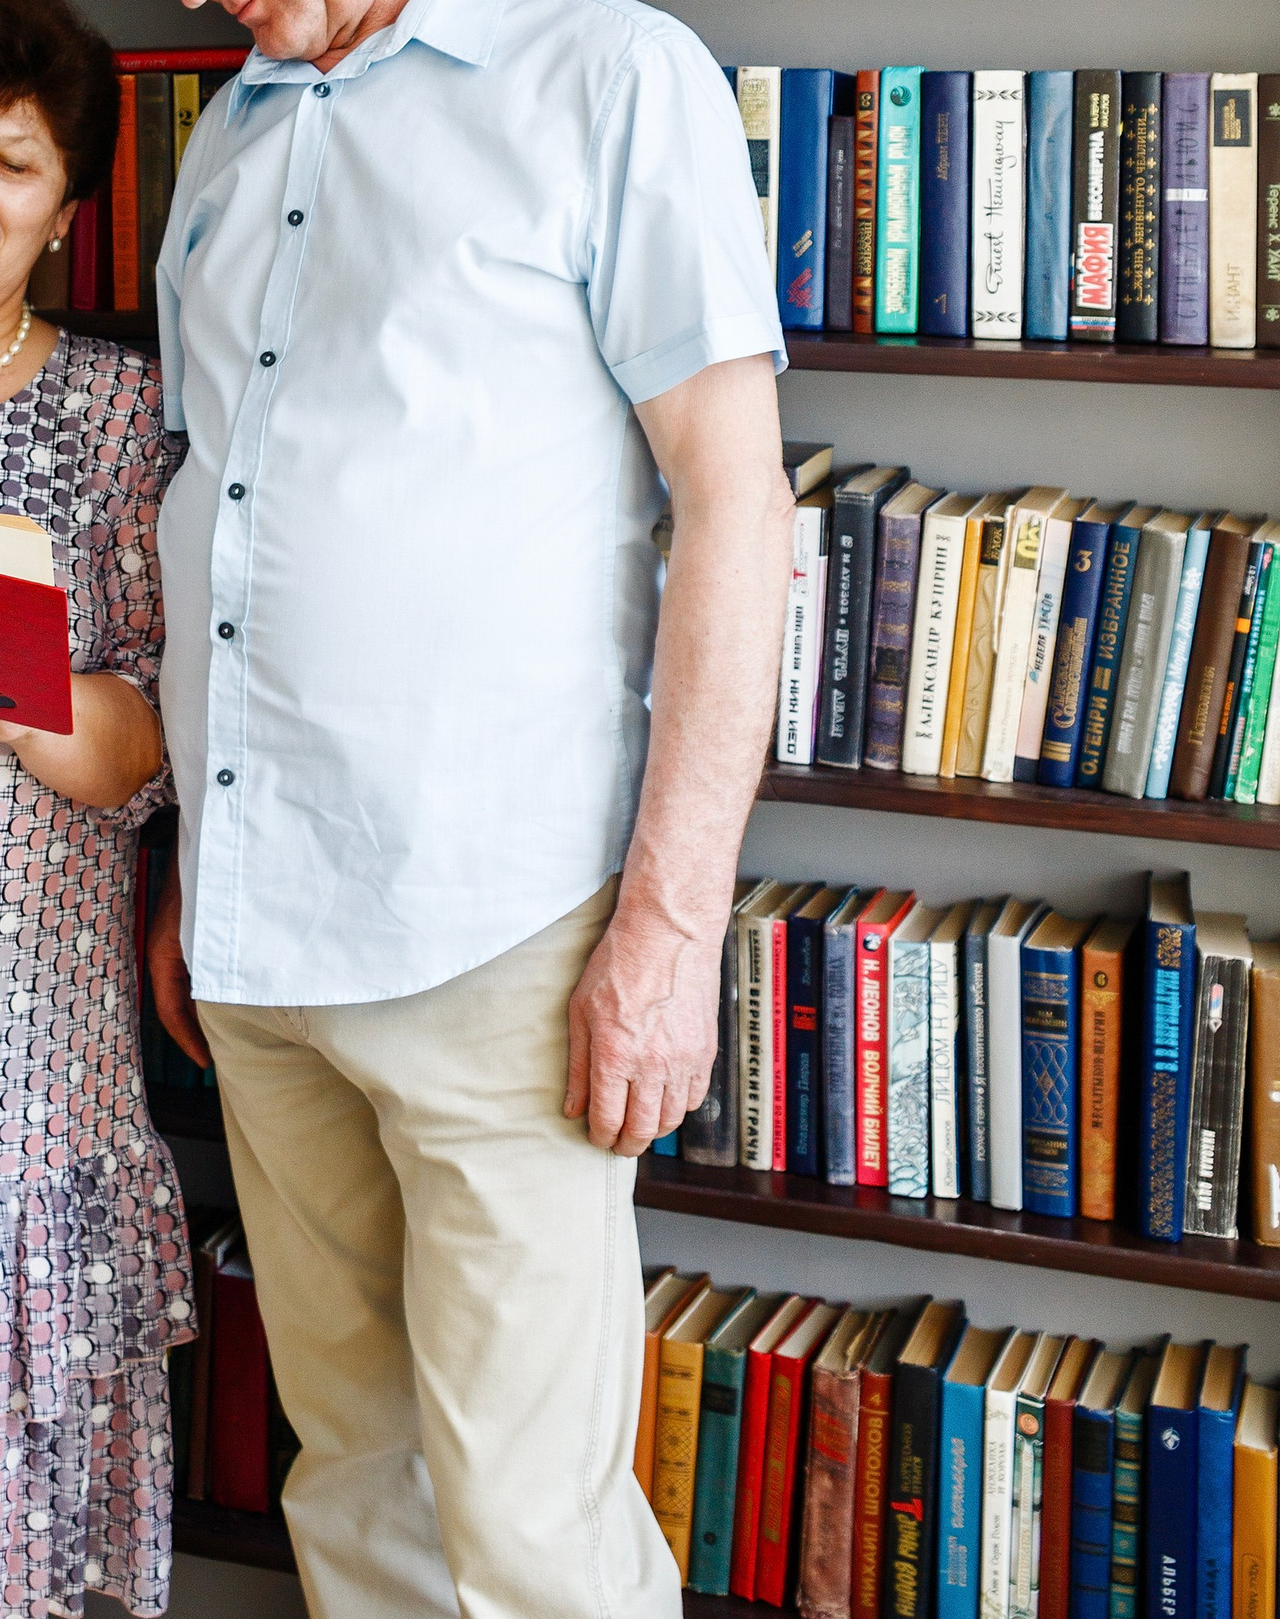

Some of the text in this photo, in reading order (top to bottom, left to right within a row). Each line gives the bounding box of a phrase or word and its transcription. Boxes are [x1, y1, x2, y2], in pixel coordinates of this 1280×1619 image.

[1091, 93, 1100, 127] ВАЛЕРИЙ
[1101, 94, 1110, 127] МАСЛОВ
[984, 120, 1017, 294] Ernest Hemingway
[1079, 131, 1107, 306] МАФИЯ БЕССМЕРТНА
[1134, 118, 1147, 289] ЖИЗНЬ БЕНВЕНУТО ЧЕЛЛИНИ
[920, 546, 949, 728] АЛЕКСАНДР КУПРИН
[1099, 541, 1131, 660] ИЗБРАННОЕ
[863, 981, 881, 1041] ЛЕОНОВ
[931, 959, 950, 1008] ЛИЦУ
[862, 1050, 882, 1170] ВОЛЧИЙ БИЛЕТ
[934, 1038, 951, 1103] ЛИЦОМ
[747, 1108, 759, 1161] ГРАЧИ
[861, 1416, 884, 1607] МИХАИЛ ШОЛОХОВ
